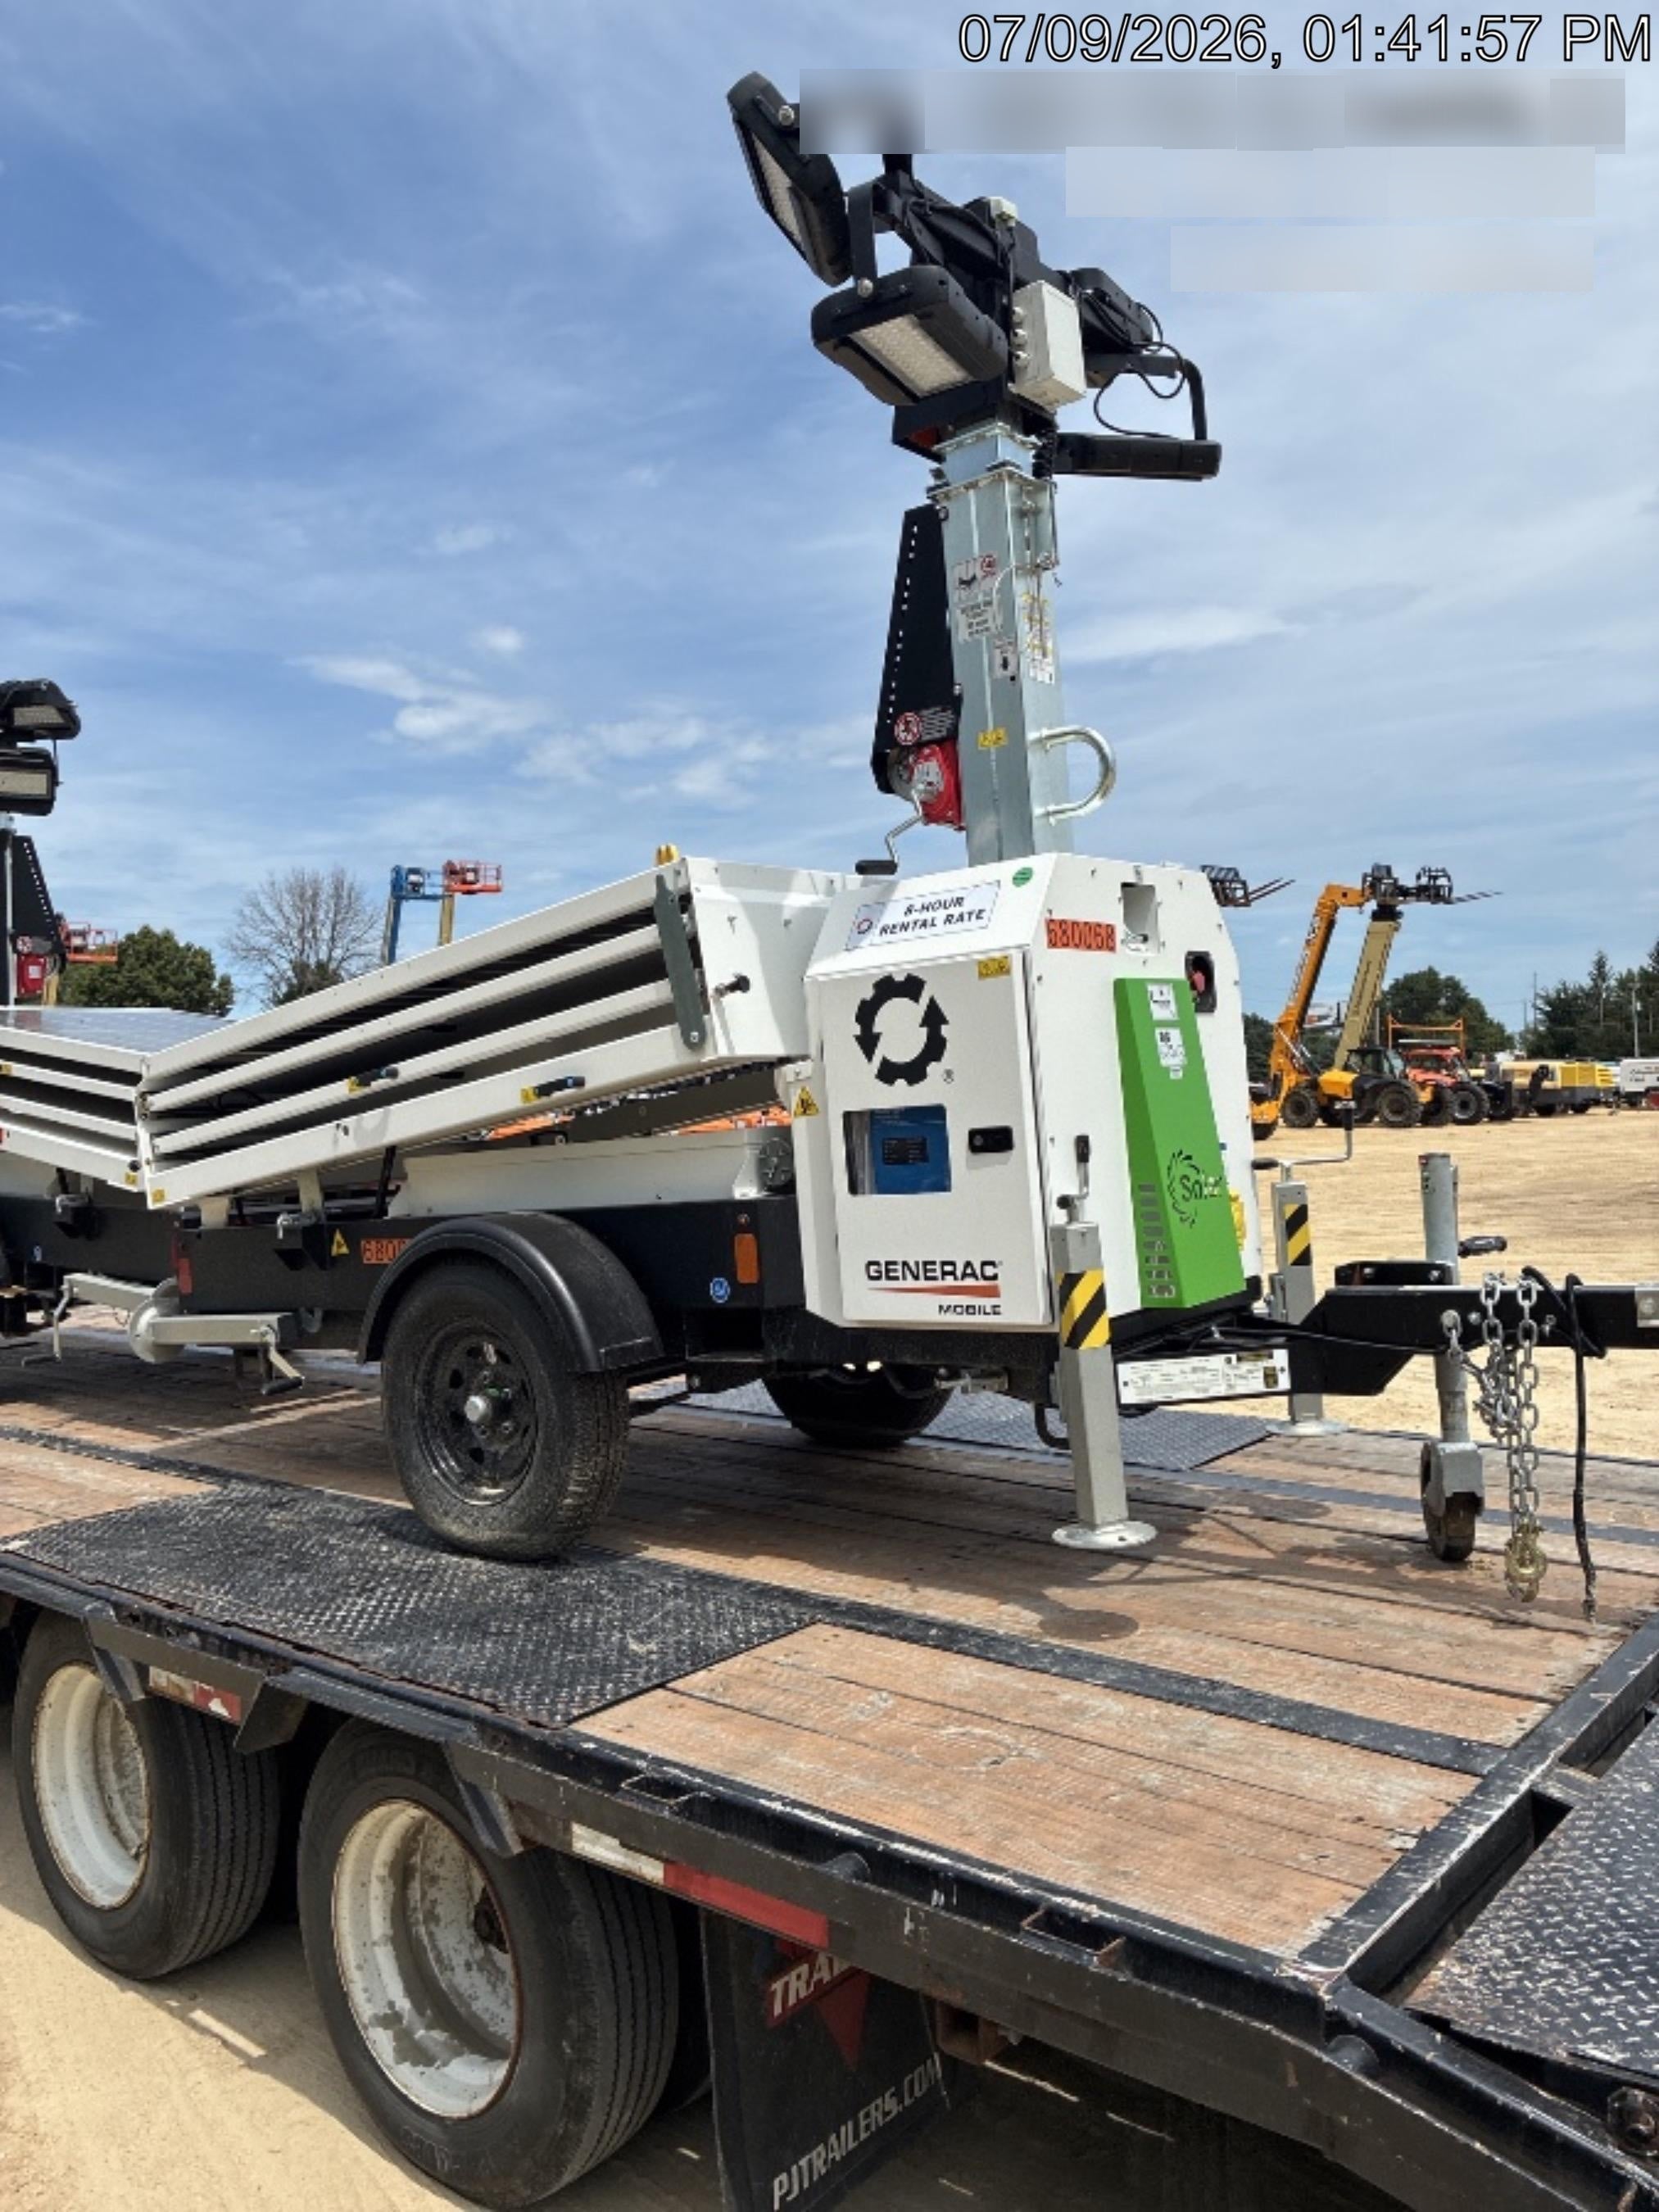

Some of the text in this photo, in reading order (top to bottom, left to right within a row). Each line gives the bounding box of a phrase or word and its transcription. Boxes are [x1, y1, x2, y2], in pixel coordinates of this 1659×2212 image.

[879, 909, 986, 937] RENTAL RATE
[865, 1260, 999, 1281] GENERAC
[938, 1303, 1002, 1316] MOBILE
[773, 2051, 942, 2211] PJTRAILERS.COM
